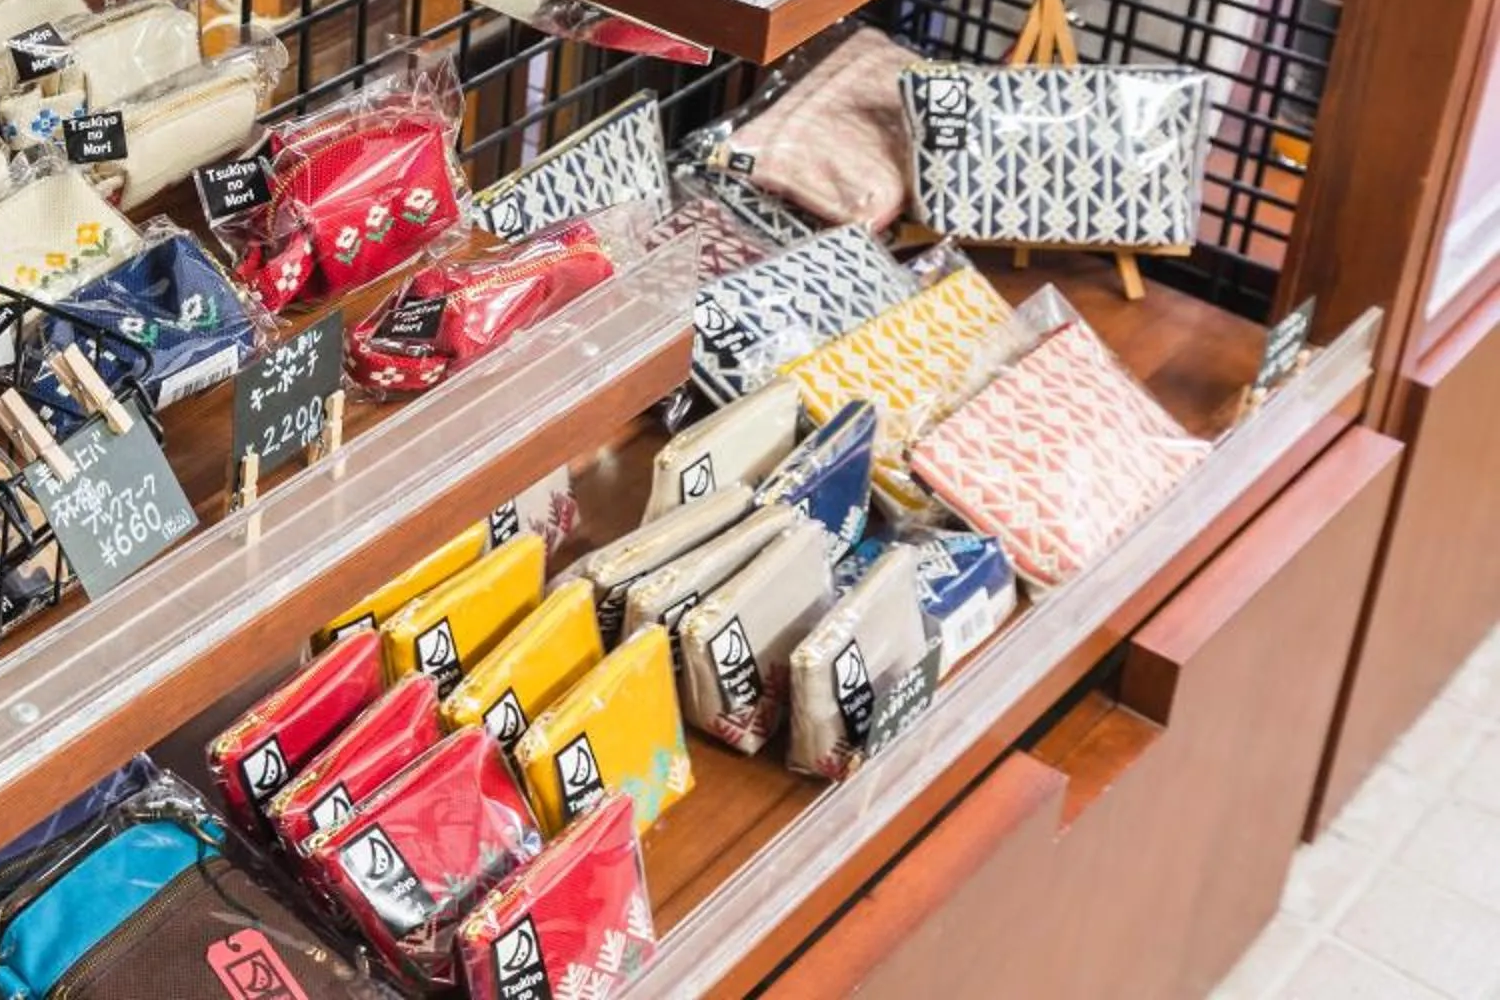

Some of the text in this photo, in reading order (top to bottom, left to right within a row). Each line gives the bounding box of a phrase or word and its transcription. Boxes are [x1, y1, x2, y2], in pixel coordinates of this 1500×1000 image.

[68, 114, 119, 132] Tsukiyo
[86, 130, 103, 141] no
[83, 141, 112, 156] Mori
[205, 161, 257, 183] Tsukiyo
[227, 180, 244, 192] no
[223, 191, 255, 208] Mori
[98, 501, 163, 568] ¥660
[502, 970, 544, 999] Tsukiyo
